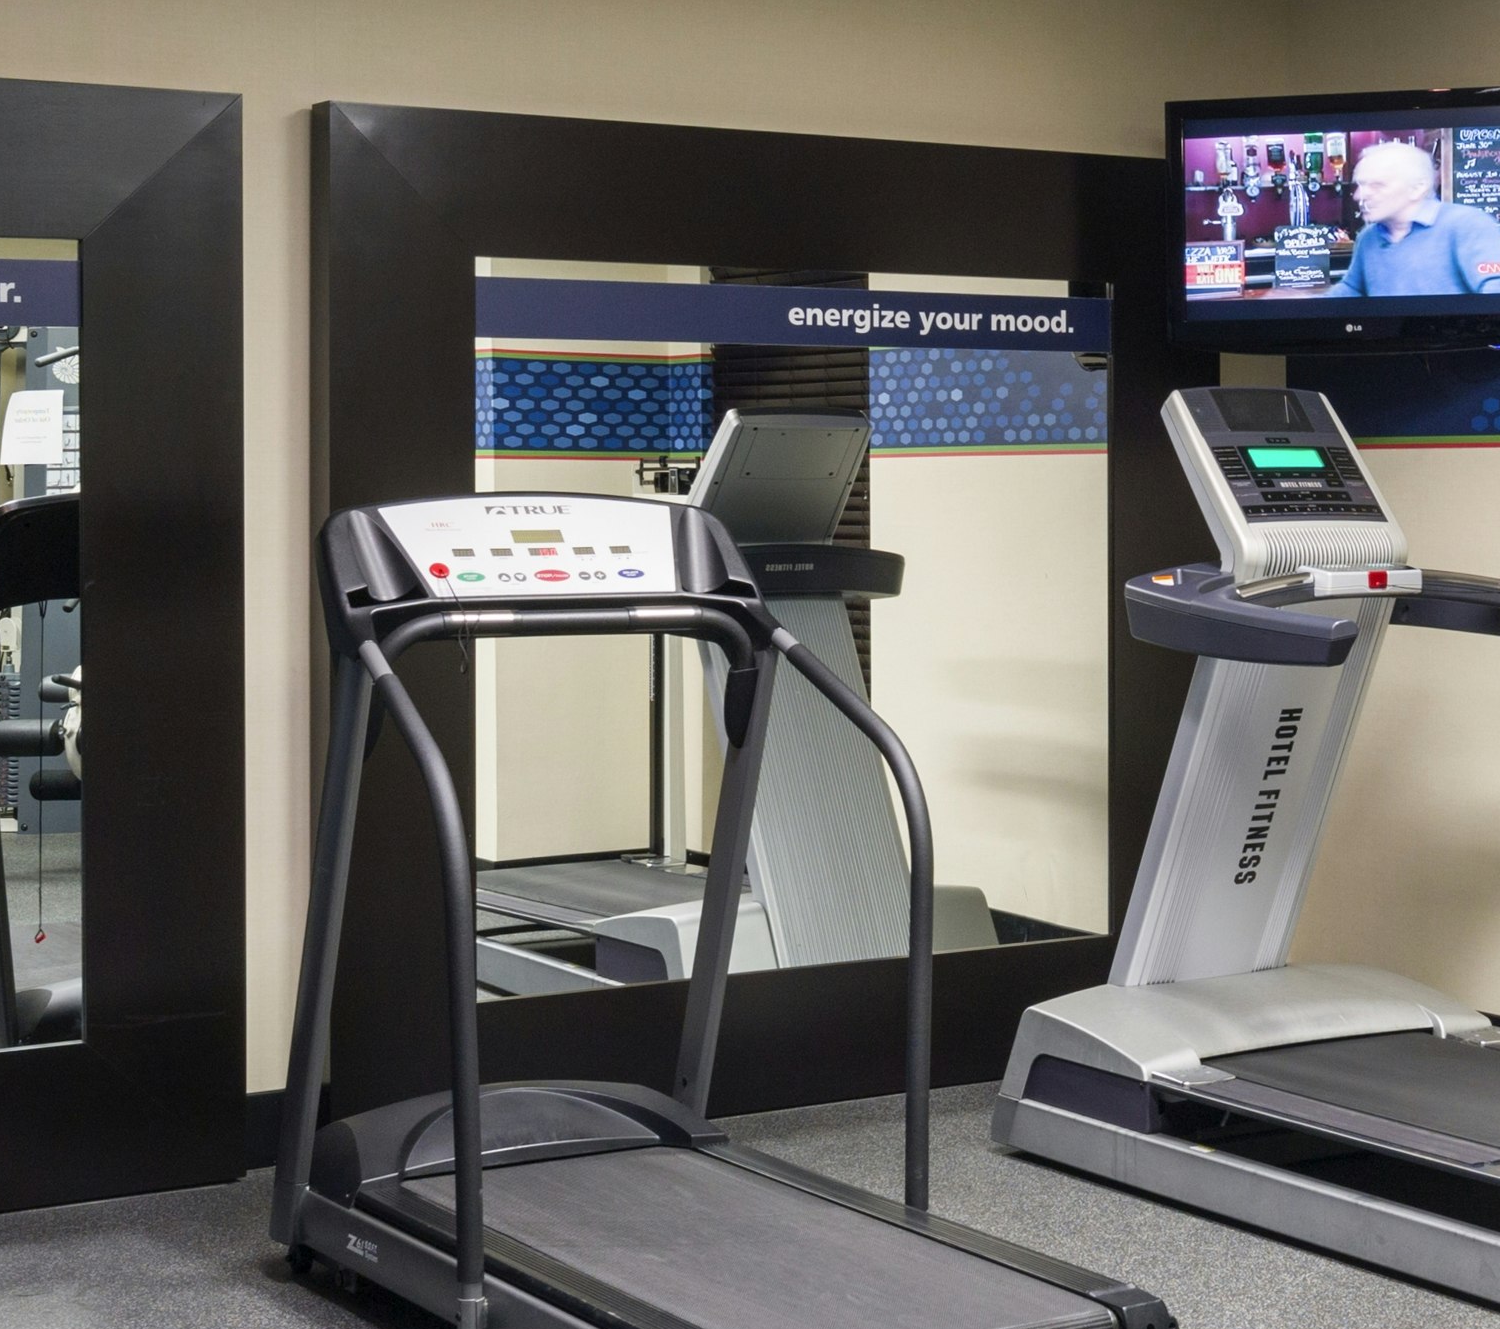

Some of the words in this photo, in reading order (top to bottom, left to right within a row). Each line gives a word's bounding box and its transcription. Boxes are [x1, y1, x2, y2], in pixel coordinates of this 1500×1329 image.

[788, 303, 911, 333] energize
[919, 311, 982, 335] your
[990, 310, 1074, 333] mood.
[505, 505, 572, 515] TRUE
[1262, 707, 1304, 781] HOTEL
[1234, 788, 1281, 885] FITNESS
